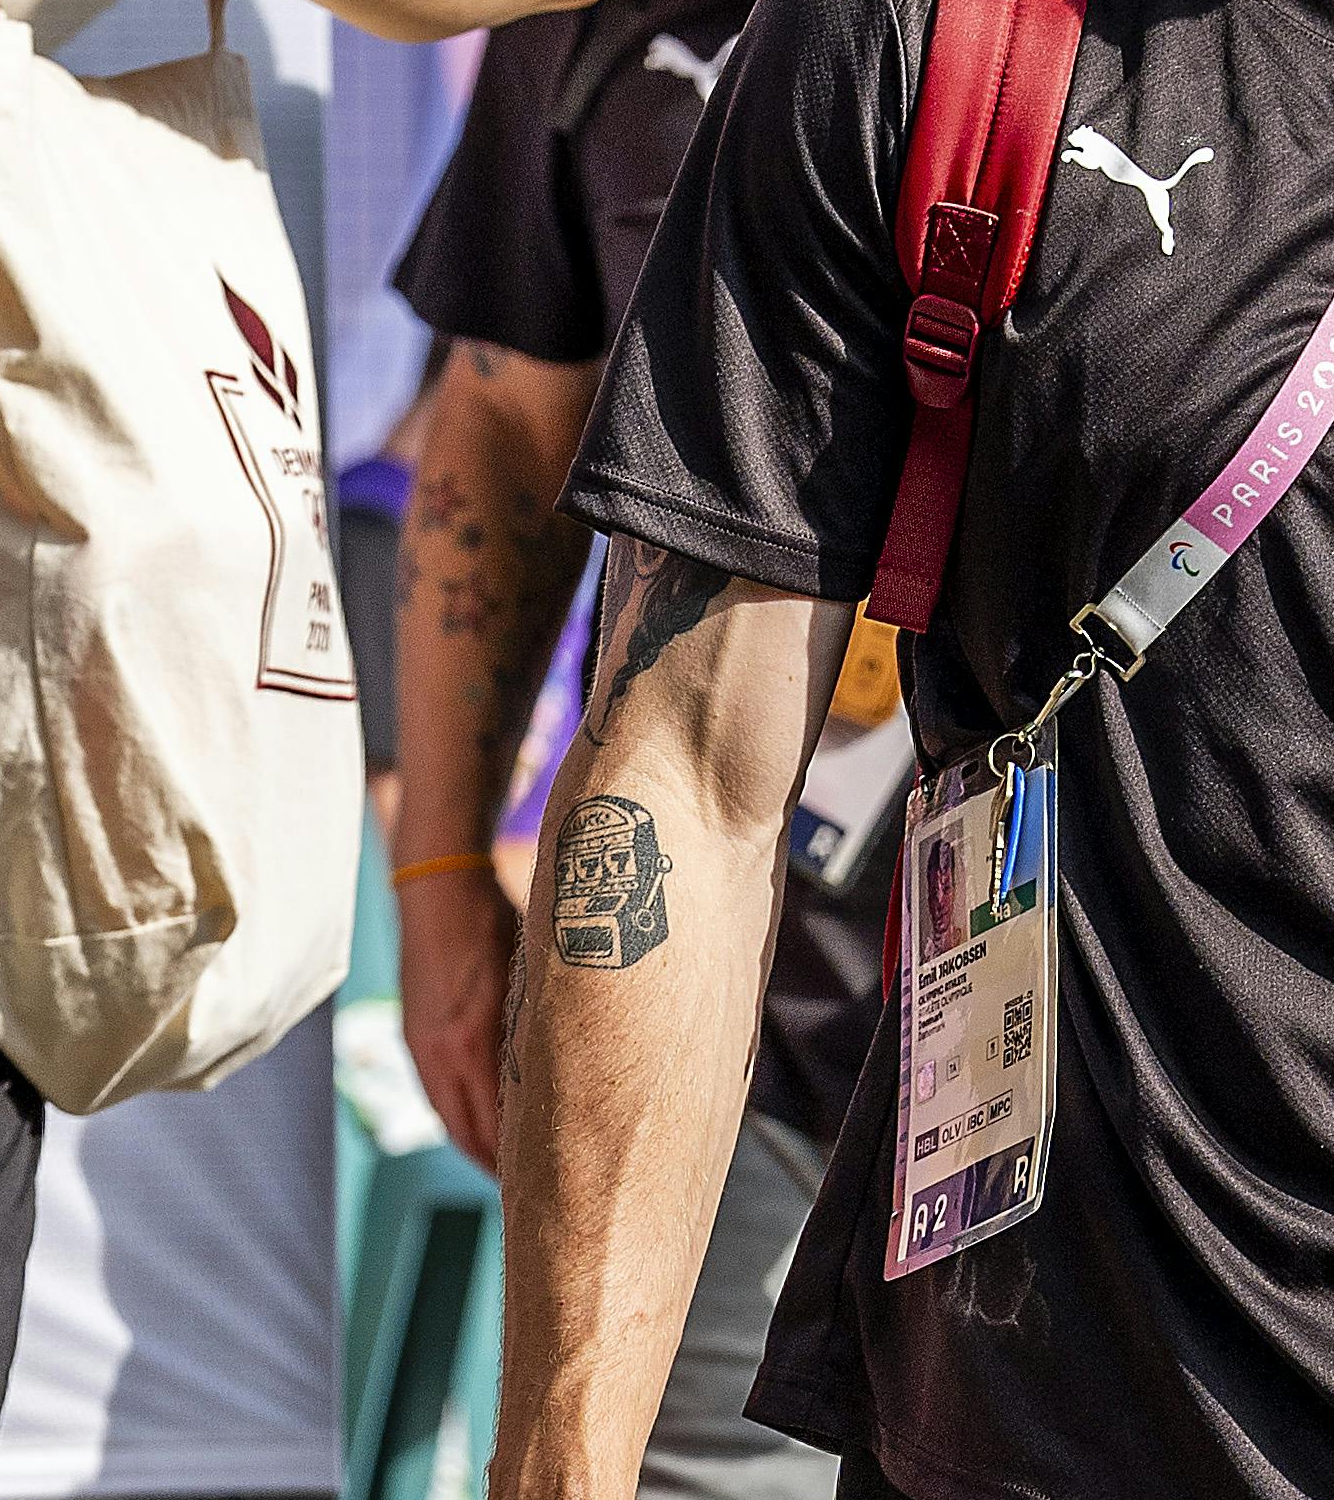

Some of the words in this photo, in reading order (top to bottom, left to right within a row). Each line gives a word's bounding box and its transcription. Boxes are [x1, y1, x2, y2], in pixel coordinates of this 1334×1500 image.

[1212, 420, 1304, 529] PARIS
[918, 965, 937, 990] Emil
[938, 939, 987, 980] JAKOBSEN
[916, 1135, 937, 1157] HBL
[941, 1121, 962, 1144] OLV
[967, 1110, 985, 1131] IBC
[989, 1097, 1012, 1120] MPC
[1013, 1154, 1029, 1195] R
